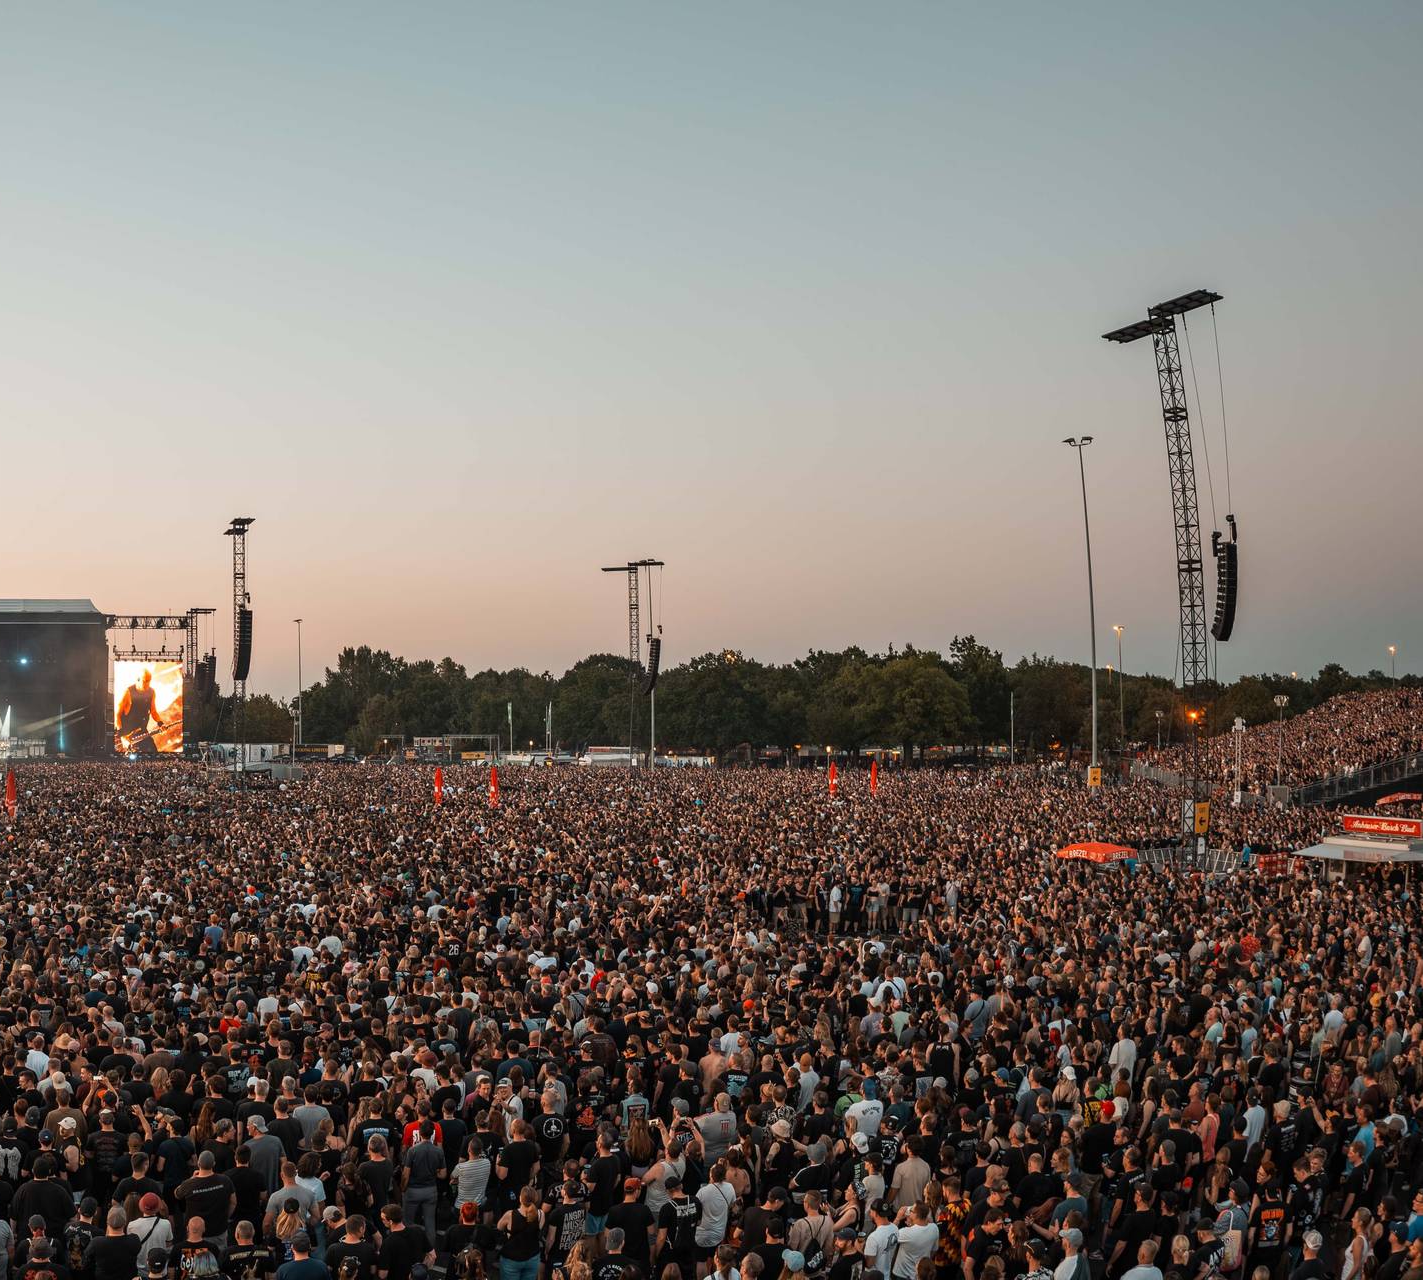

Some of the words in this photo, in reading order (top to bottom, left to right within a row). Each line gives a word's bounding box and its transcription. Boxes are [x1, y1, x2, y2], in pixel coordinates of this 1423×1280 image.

[1400, 823, 1417, 833] Bud
[448, 944, 460, 956] 26
[564, 1209, 585, 1222] ANGRY
